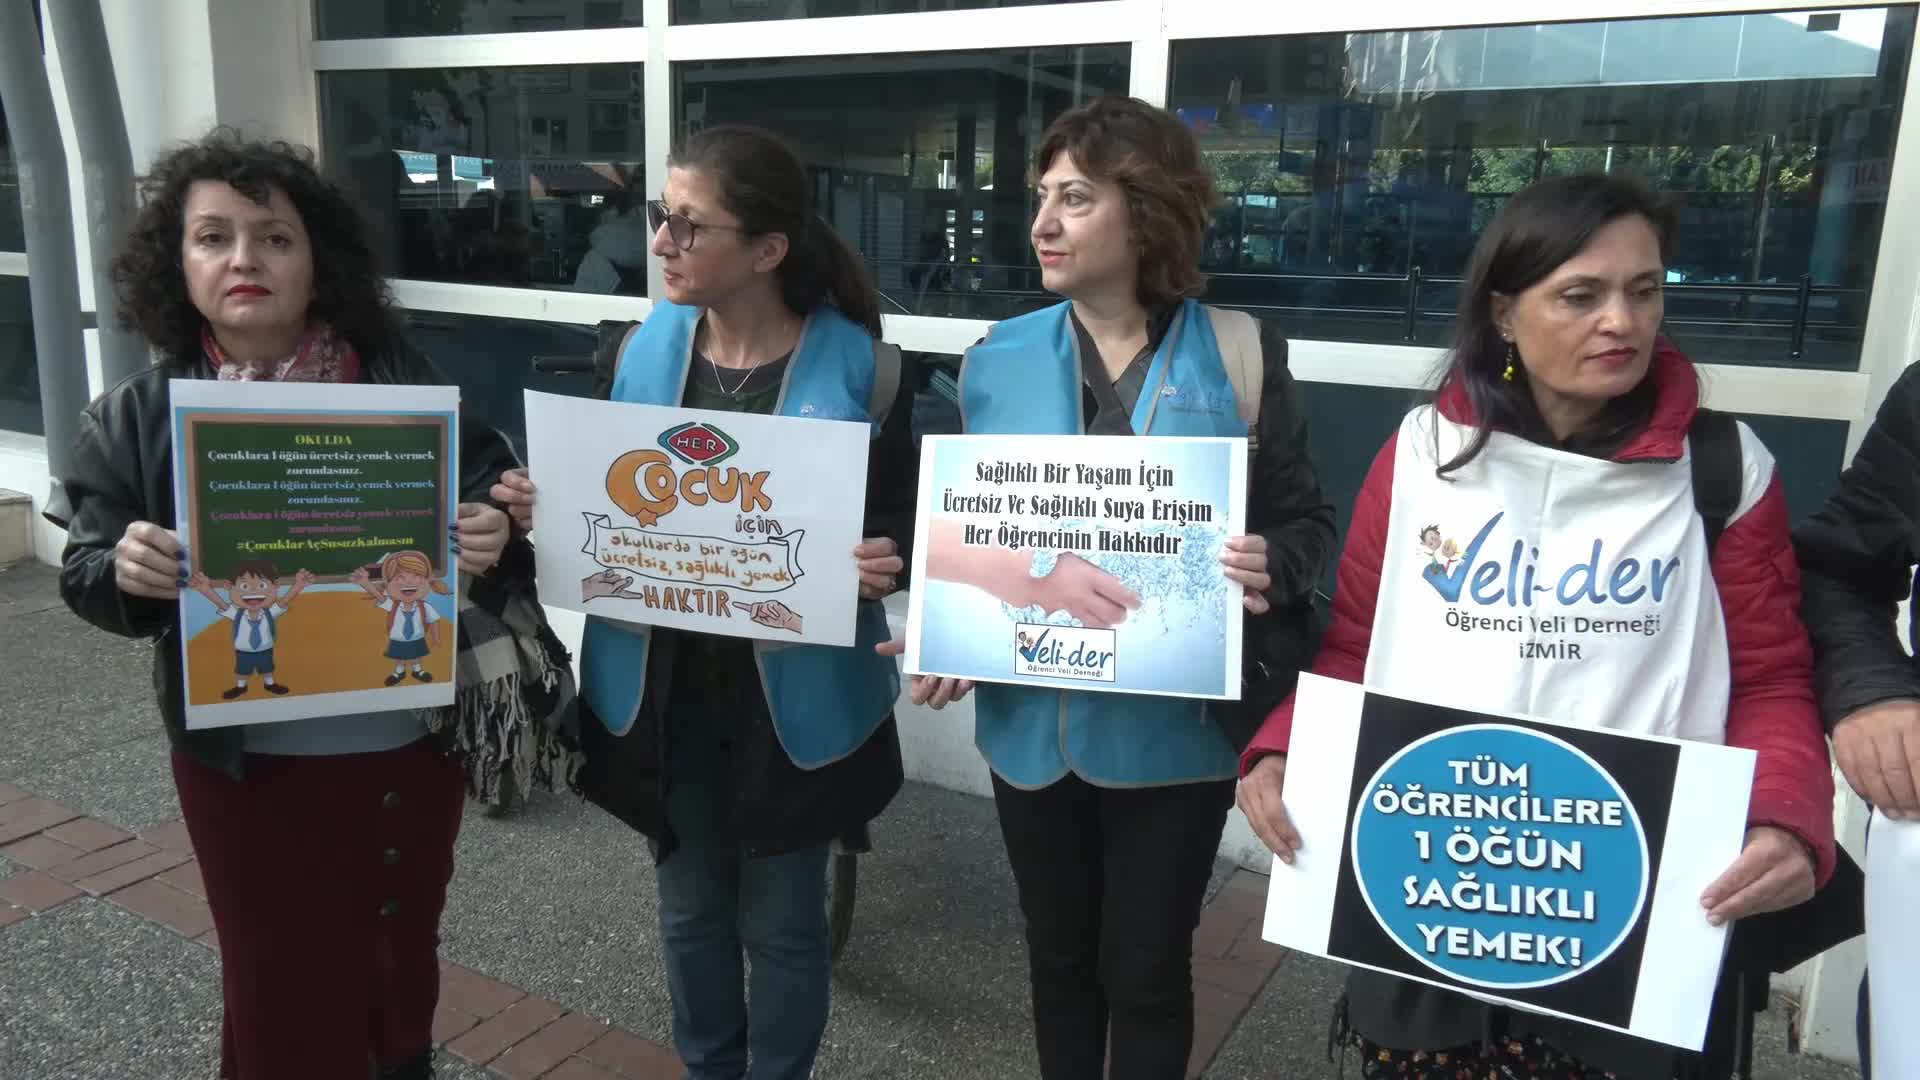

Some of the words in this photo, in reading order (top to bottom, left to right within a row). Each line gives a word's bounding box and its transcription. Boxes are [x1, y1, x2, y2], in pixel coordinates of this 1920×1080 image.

[208, 450, 269, 462] Çocuklara
[279, 451, 307, 462] öğün
[309, 450, 355, 460] ücretsiz
[356, 450, 392, 462] yemek
[394, 450, 435, 460] vermek
[295, 434, 352, 445] OKULDA
[677, 436, 717, 451] HER
[606, 449, 772, 527] ÇOCUK
[975, 461, 1037, 486] Sağlıklı
[1044, 462, 1070, 484] Bir
[1075, 464, 1132, 490] Yaşam
[1139, 460, 1174, 491] İçin
[943, 489, 1002, 514] Ücretsiz
[1008, 495, 1025, 515] Ve
[1030, 494, 1098, 520] Sağlıklı
[1103, 498, 1145, 523] Suya
[1152, 499, 1213, 527] Erişim
[735, 513, 783, 539] için
[964, 524, 992, 545] Her
[997, 522, 1092, 551] Öğrencinin
[1098, 530, 1182, 555] Hakkıdır
[611, 531, 690, 552] okullarda
[700, 543, 724, 556] bir
[731, 545, 772, 564] öğün
[1422, 511, 1680, 607] Veli-der
[601, 548, 672, 576] ücretsiz,
[676, 559, 736, 581] sağlıklı
[741, 568, 791, 586] yemek
[643, 584, 732, 617] HAKTIR
[1445, 608, 1523, 632] Öğrenci
[1575, 614, 1661, 636] Derneği
[1019, 628, 1113, 669] Veli-der
[1027, 664, 1055, 673] Öğrenci
[1058, 667, 1071, 675] Veli
[1448, 755, 1528, 788] TÜM
[1372, 783, 1623, 826] ÖĞRENCİLERE
[1414, 830, 1430, 860] 1
[1446, 825, 1582, 872] ÖĞÜN
[1403, 871, 1595, 921] SAĞLIKLI
[1416, 923, 1583, 968] YEMEK!
